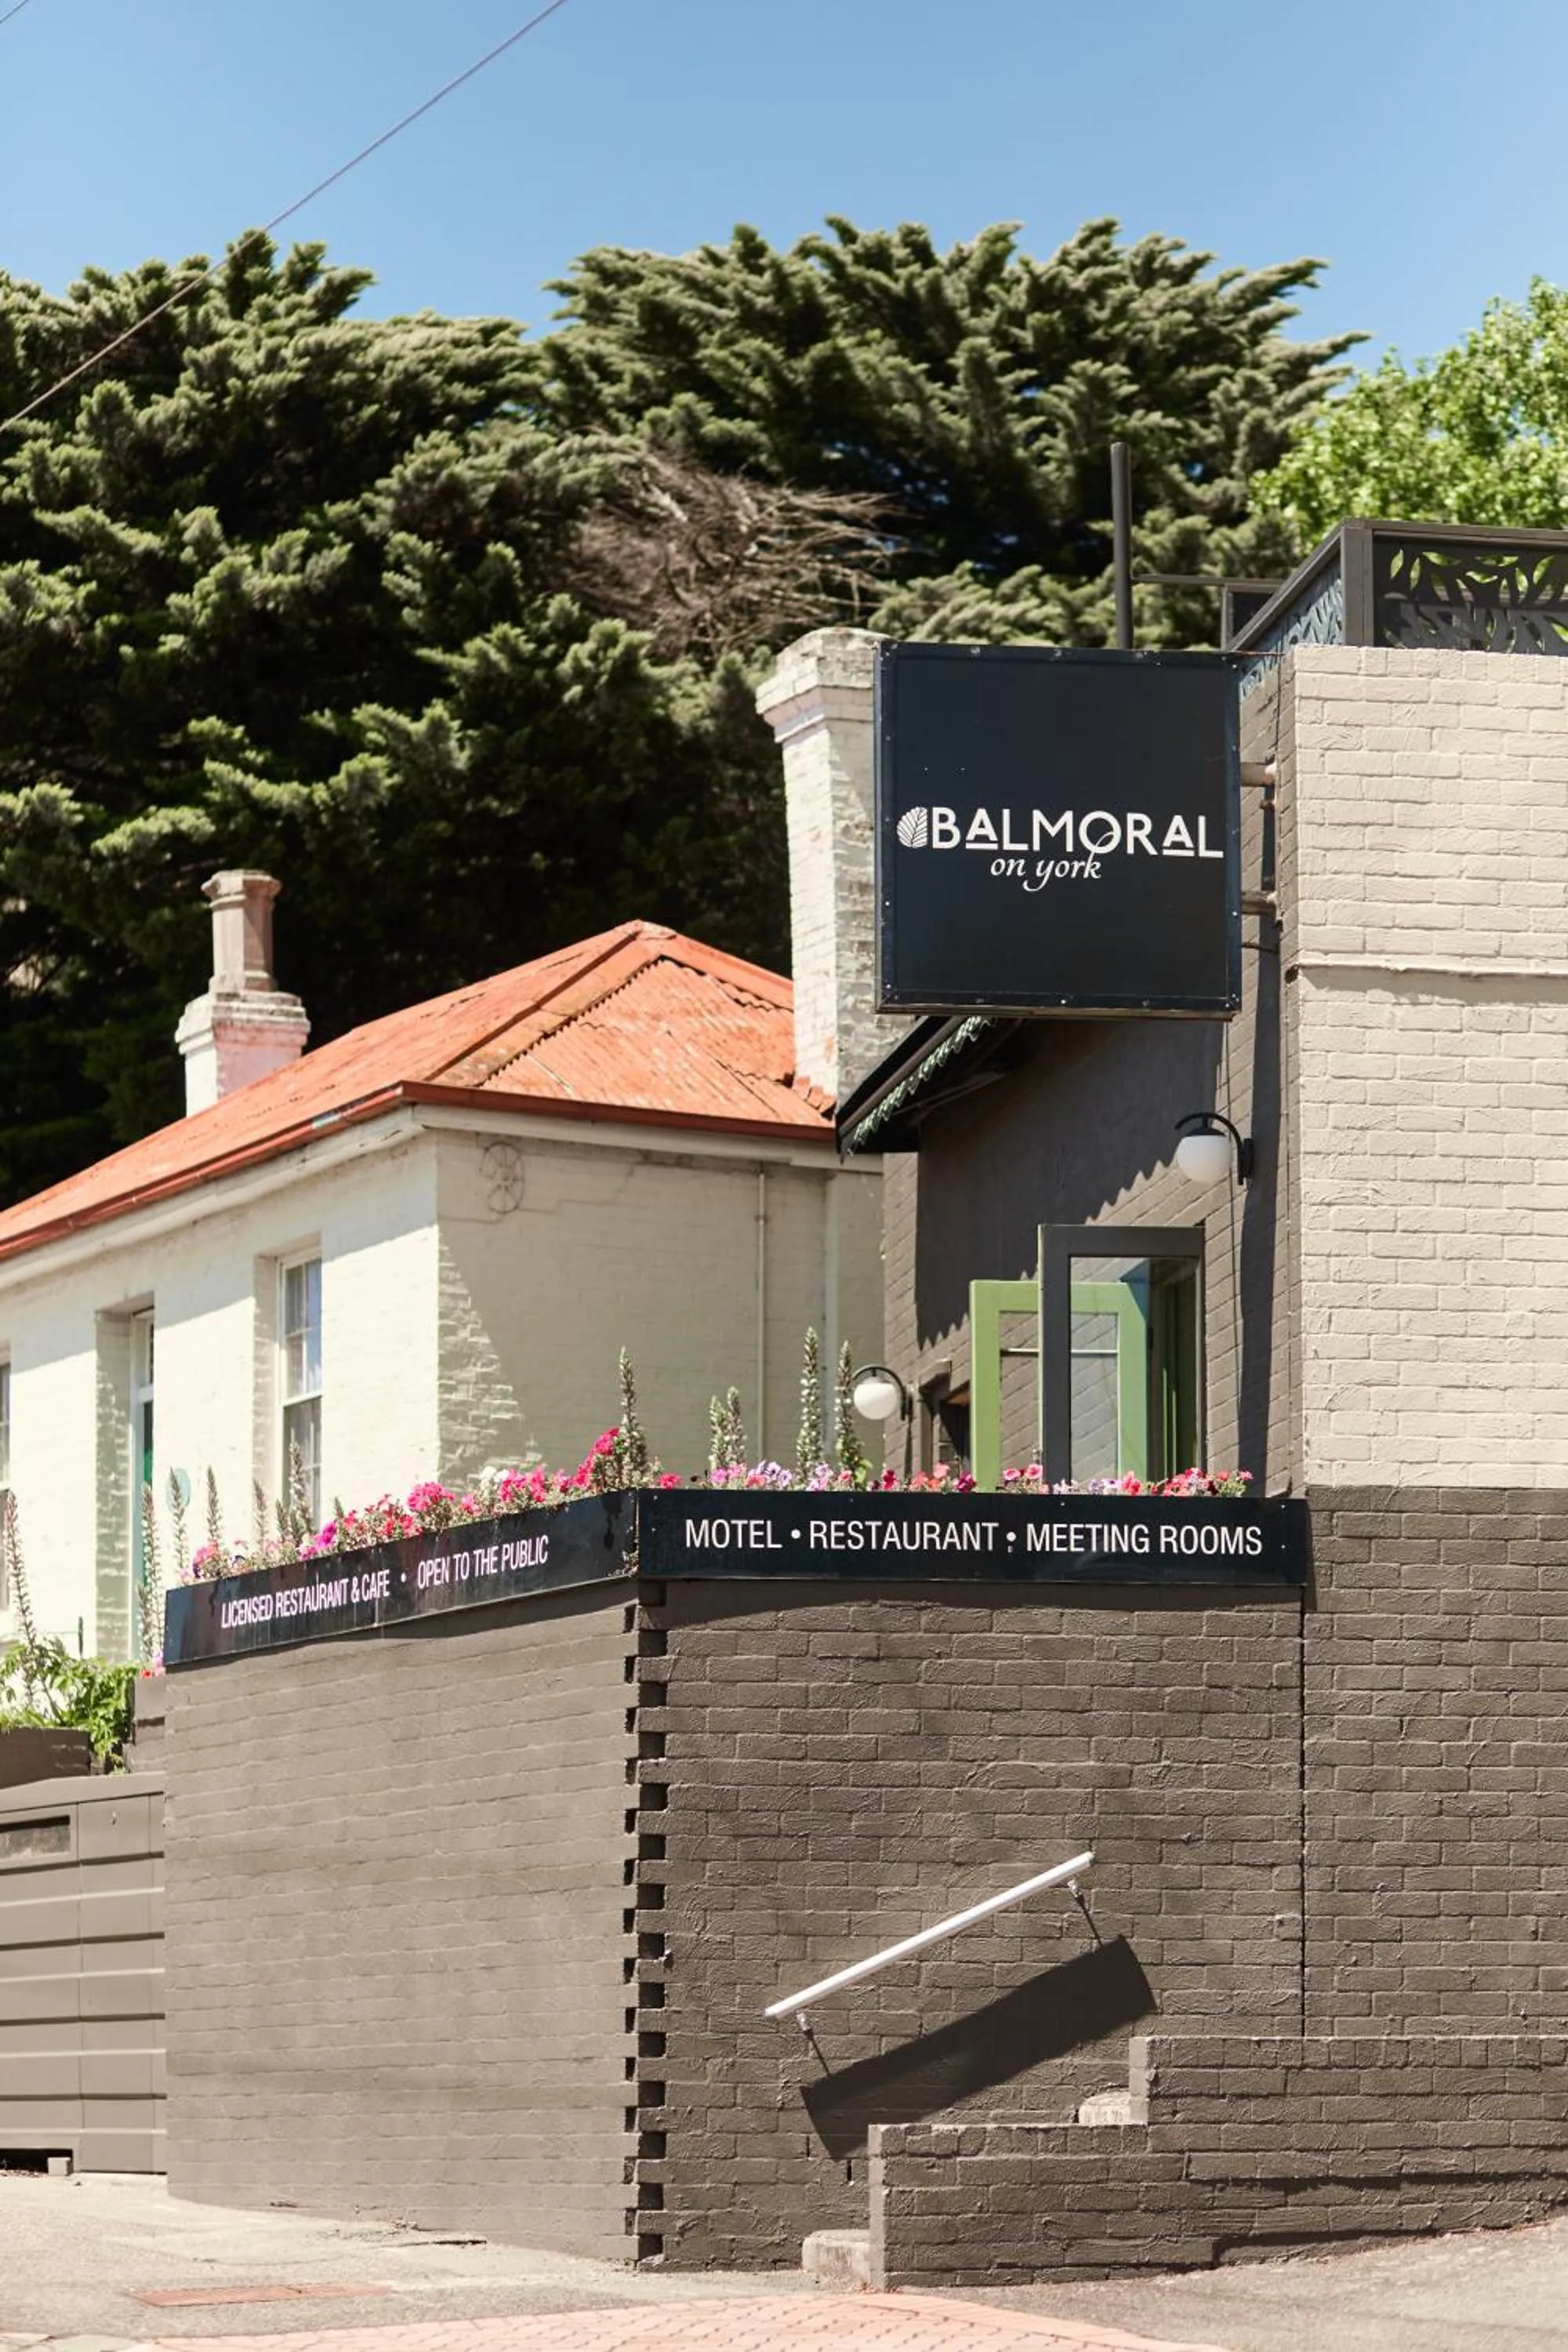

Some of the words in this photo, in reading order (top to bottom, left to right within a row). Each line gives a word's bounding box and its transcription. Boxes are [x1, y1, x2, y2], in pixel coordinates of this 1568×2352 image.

[931, 806, 1224, 858] BALMORAL
[990, 858, 1026, 877] on
[1022, 846, 1102, 892] york
[685, 1519, 782, 1548] MOTEL
[810, 1520, 1000, 1551] RESTAURANT
[1026, 1523, 1150, 1554] MEETING
[1160, 1525, 1262, 1555] ROOMS
[220, 1593, 274, 1629] LICENSED
[274, 1577, 350, 1619] RESTAURANT
[350, 1575, 361, 1604] &
[361, 1569, 390, 1602] CAFE
[416, 1555, 450, 1593] OPEN
[452, 1551, 470, 1582] TO
[473, 1545, 499, 1578] THE
[500, 1534, 550, 1572] PUBLIC
